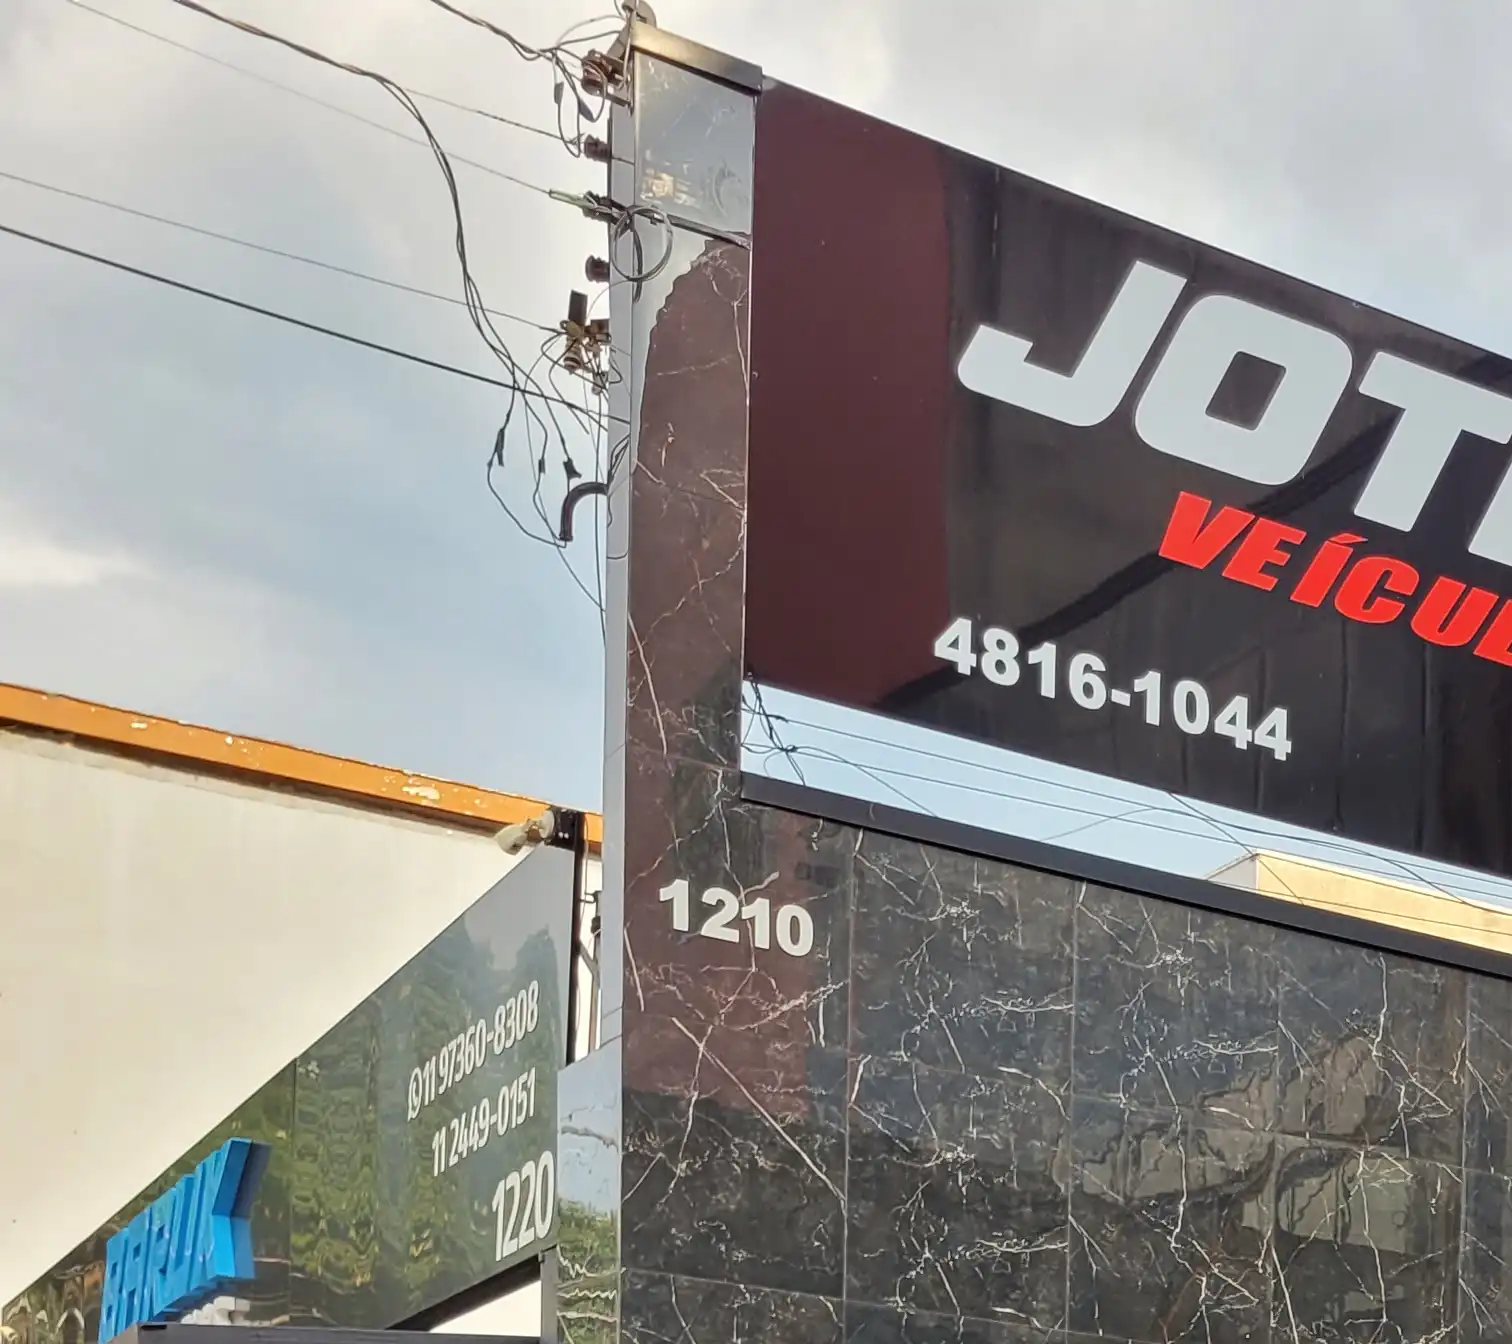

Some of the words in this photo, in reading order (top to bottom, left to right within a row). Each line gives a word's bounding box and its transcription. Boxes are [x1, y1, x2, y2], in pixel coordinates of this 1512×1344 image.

[933, 616, 1292, 761] 4816-1044
[658, 878, 814, 957] 1210
[421, 1055, 437, 1107] 11
[438, 979, 540, 1096] 97360-8308
[431, 1126, 447, 1177] 11
[448, 1066, 537, 1168] 2449-0151
[491, 1149, 555, 1262] 1220
